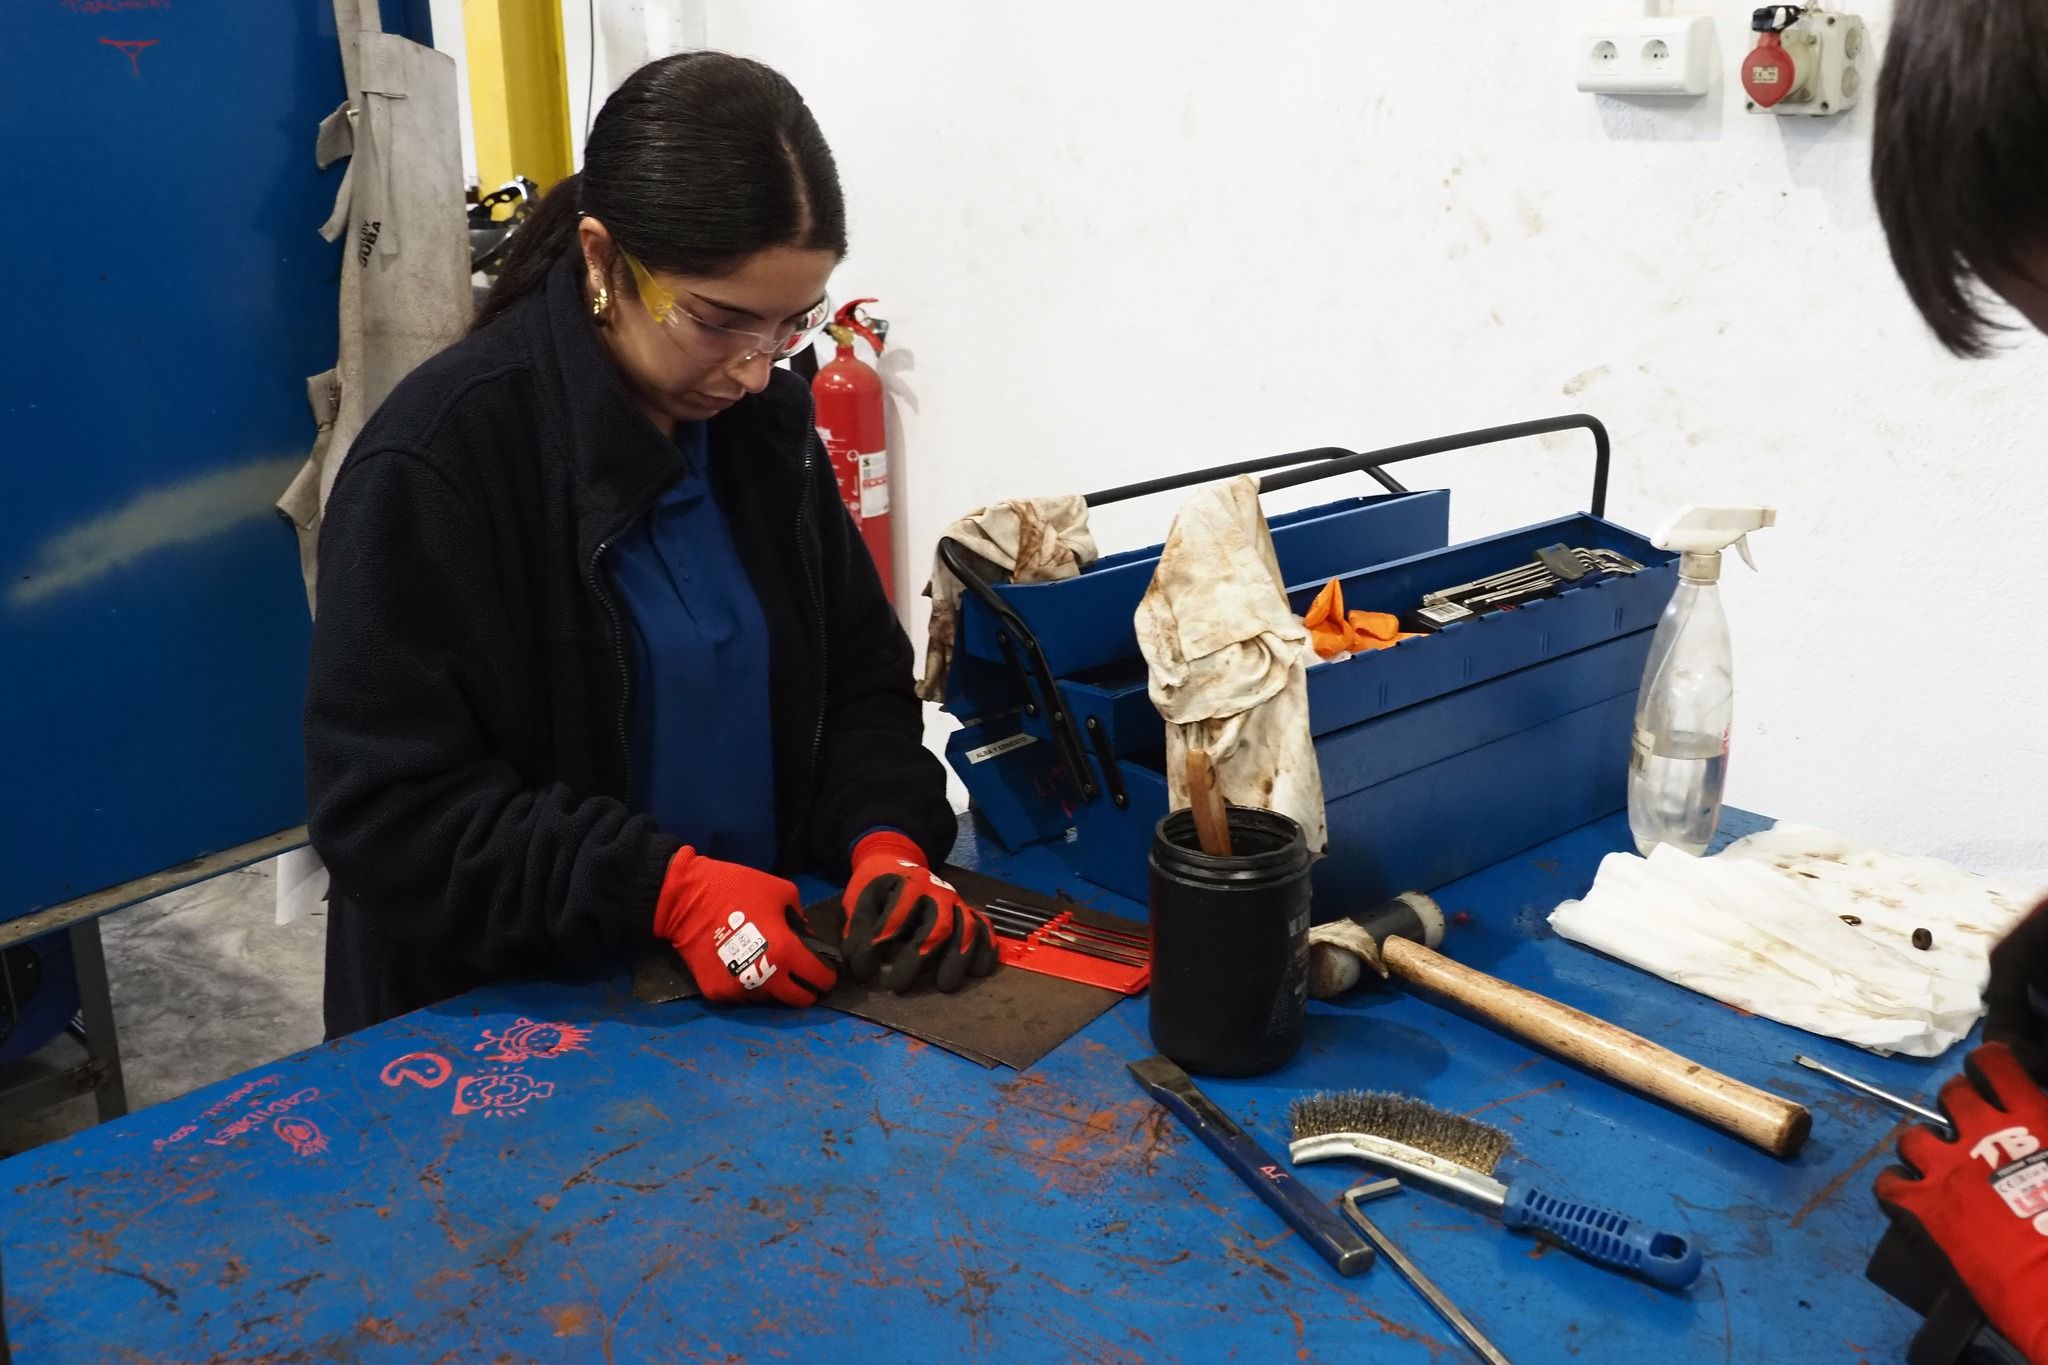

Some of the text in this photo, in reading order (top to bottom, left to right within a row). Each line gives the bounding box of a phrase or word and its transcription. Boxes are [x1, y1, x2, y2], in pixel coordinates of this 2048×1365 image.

[358, 222, 381, 268] JUBA
[738, 954, 778, 990] TB
[1969, 1126, 2040, 1170] TB
